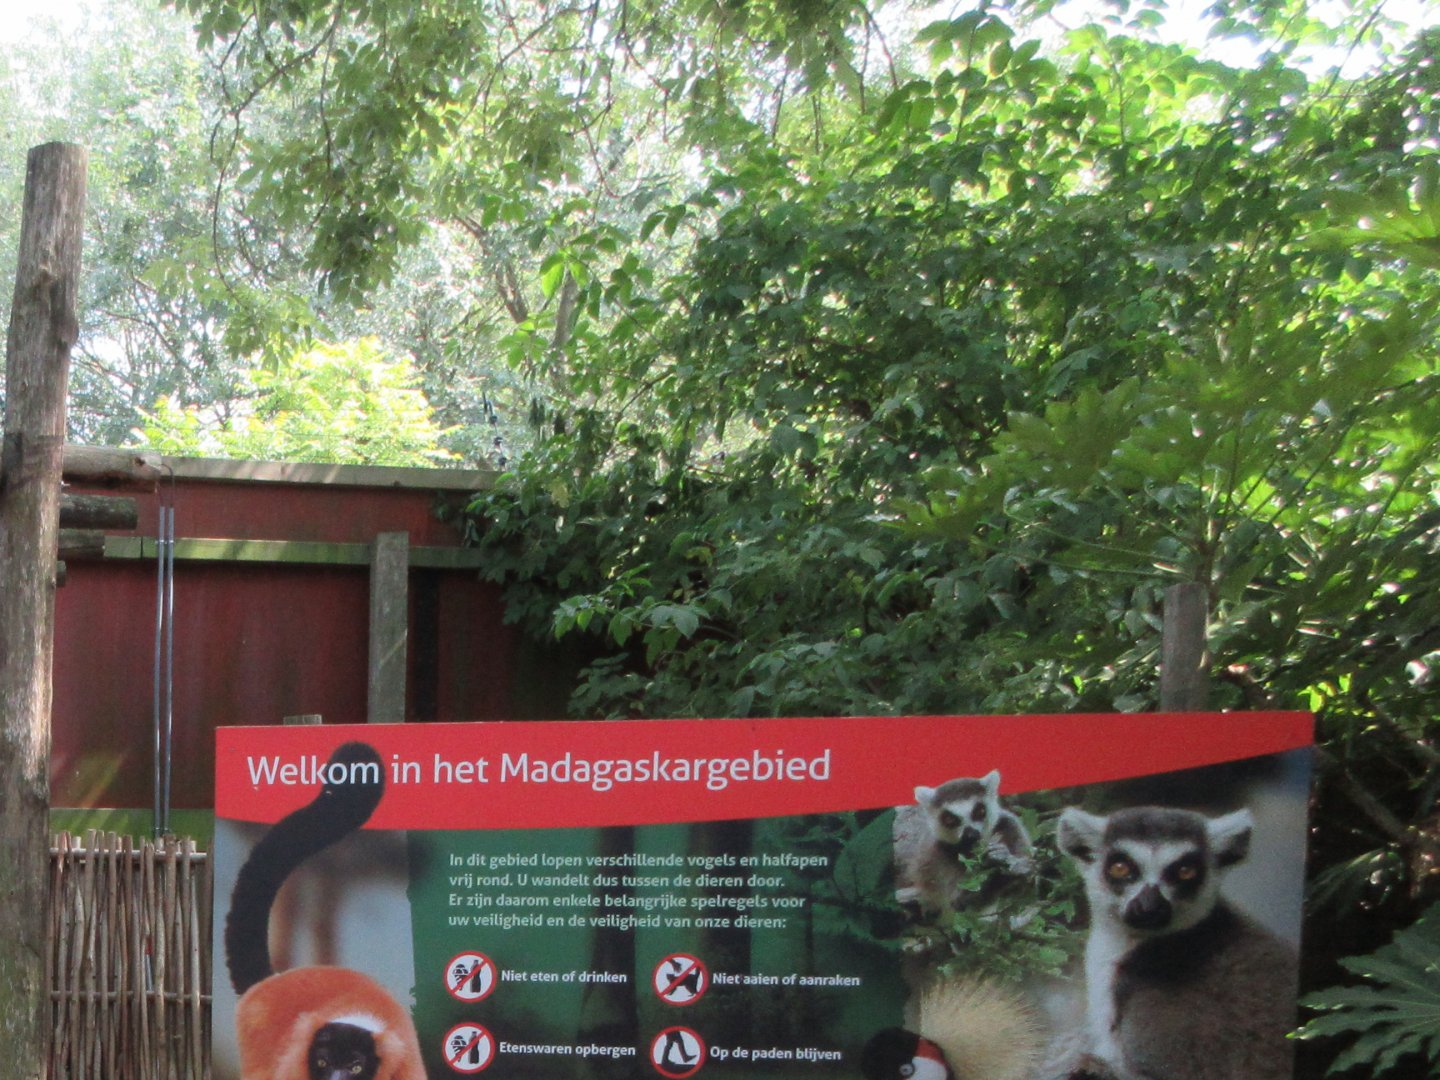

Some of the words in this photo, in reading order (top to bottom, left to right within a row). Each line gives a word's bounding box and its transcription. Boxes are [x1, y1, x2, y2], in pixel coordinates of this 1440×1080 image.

[247, 754, 379, 785] Welkom
[392, 755, 420, 784] in
[433, 754, 488, 783] het
[500, 749, 830, 791] Madagaskargebied
[449, 854, 462, 866] In
[467, 854, 486, 866] dit
[489, 854, 538, 869] gebied
[542, 854, 582, 869] lopen
[586, 853, 683, 866] verschillende
[687, 853, 736, 870] vogels
[740, 856, 758, 866] en
[762, 853, 828, 870] halfapen
[449, 874, 472, 888] vrij
[477, 874, 513, 886] rond.
[518, 874, 527, 886] U
[532, 874, 589, 886] wandelt
[592, 874, 618, 886] dus
[622, 875, 669, 887] tussen
[673, 874, 691, 887] de
[695, 874, 742, 887] dieren
[747, 874, 785, 887] door.
[449, 894, 461, 906] Er
[467, 894, 492, 908] zijn
[496, 894, 548, 906] daarom
[552, 894, 600, 907] enkele
[605, 894, 687, 910] belangrijke
[690, 895, 768, 910] spelregels
[772, 898, 806, 908] voor
[449, 916, 469, 926] uw
[473, 913, 542, 929] veiligheid
[547, 917, 564, 926] en
[568, 914, 585, 926] de
[589, 914, 660, 930] veiligheid
[664, 918, 690, 928] van
[695, 918, 730, 928] onze
[734, 915, 786, 928] dieren:
[501, 970, 527, 981] Niet
[530, 972, 559, 982] eten
[562, 971, 576, 982] of
[578, 971, 627, 983] drinken
[712, 973, 740, 984] Niet
[743, 974, 778, 985] aaien
[782, 974, 797, 985] of
[799, 975, 860, 986] aanraken
[499, 1042, 572, 1054] Etenswaren
[575, 1044, 636, 1058] opbergen
[710, 1046, 728, 1060] Op
[732, 1047, 748, 1058] de
[752, 1048, 792, 1061] paden
[796, 1048, 841, 1062] blijven
